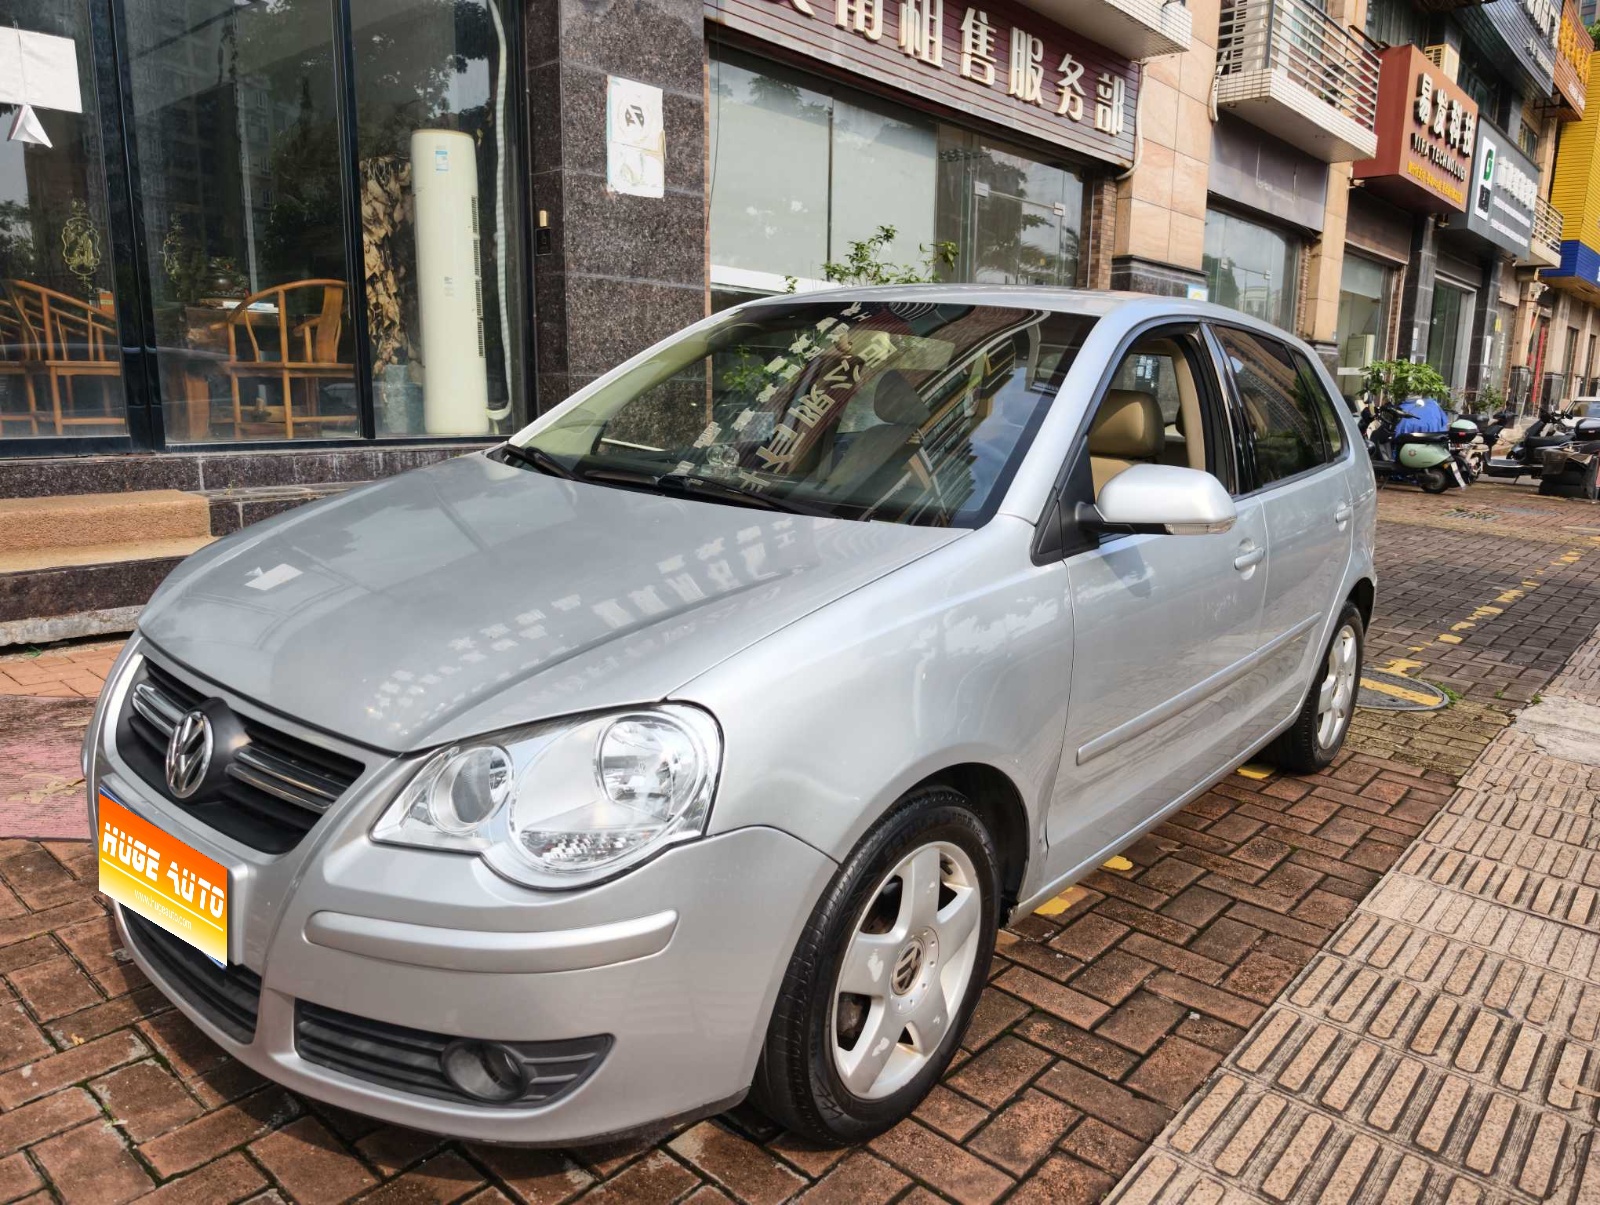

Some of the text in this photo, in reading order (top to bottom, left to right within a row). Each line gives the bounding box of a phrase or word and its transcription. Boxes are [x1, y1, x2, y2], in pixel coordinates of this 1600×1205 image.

[789, 0, 1125, 136] 租售服务部
